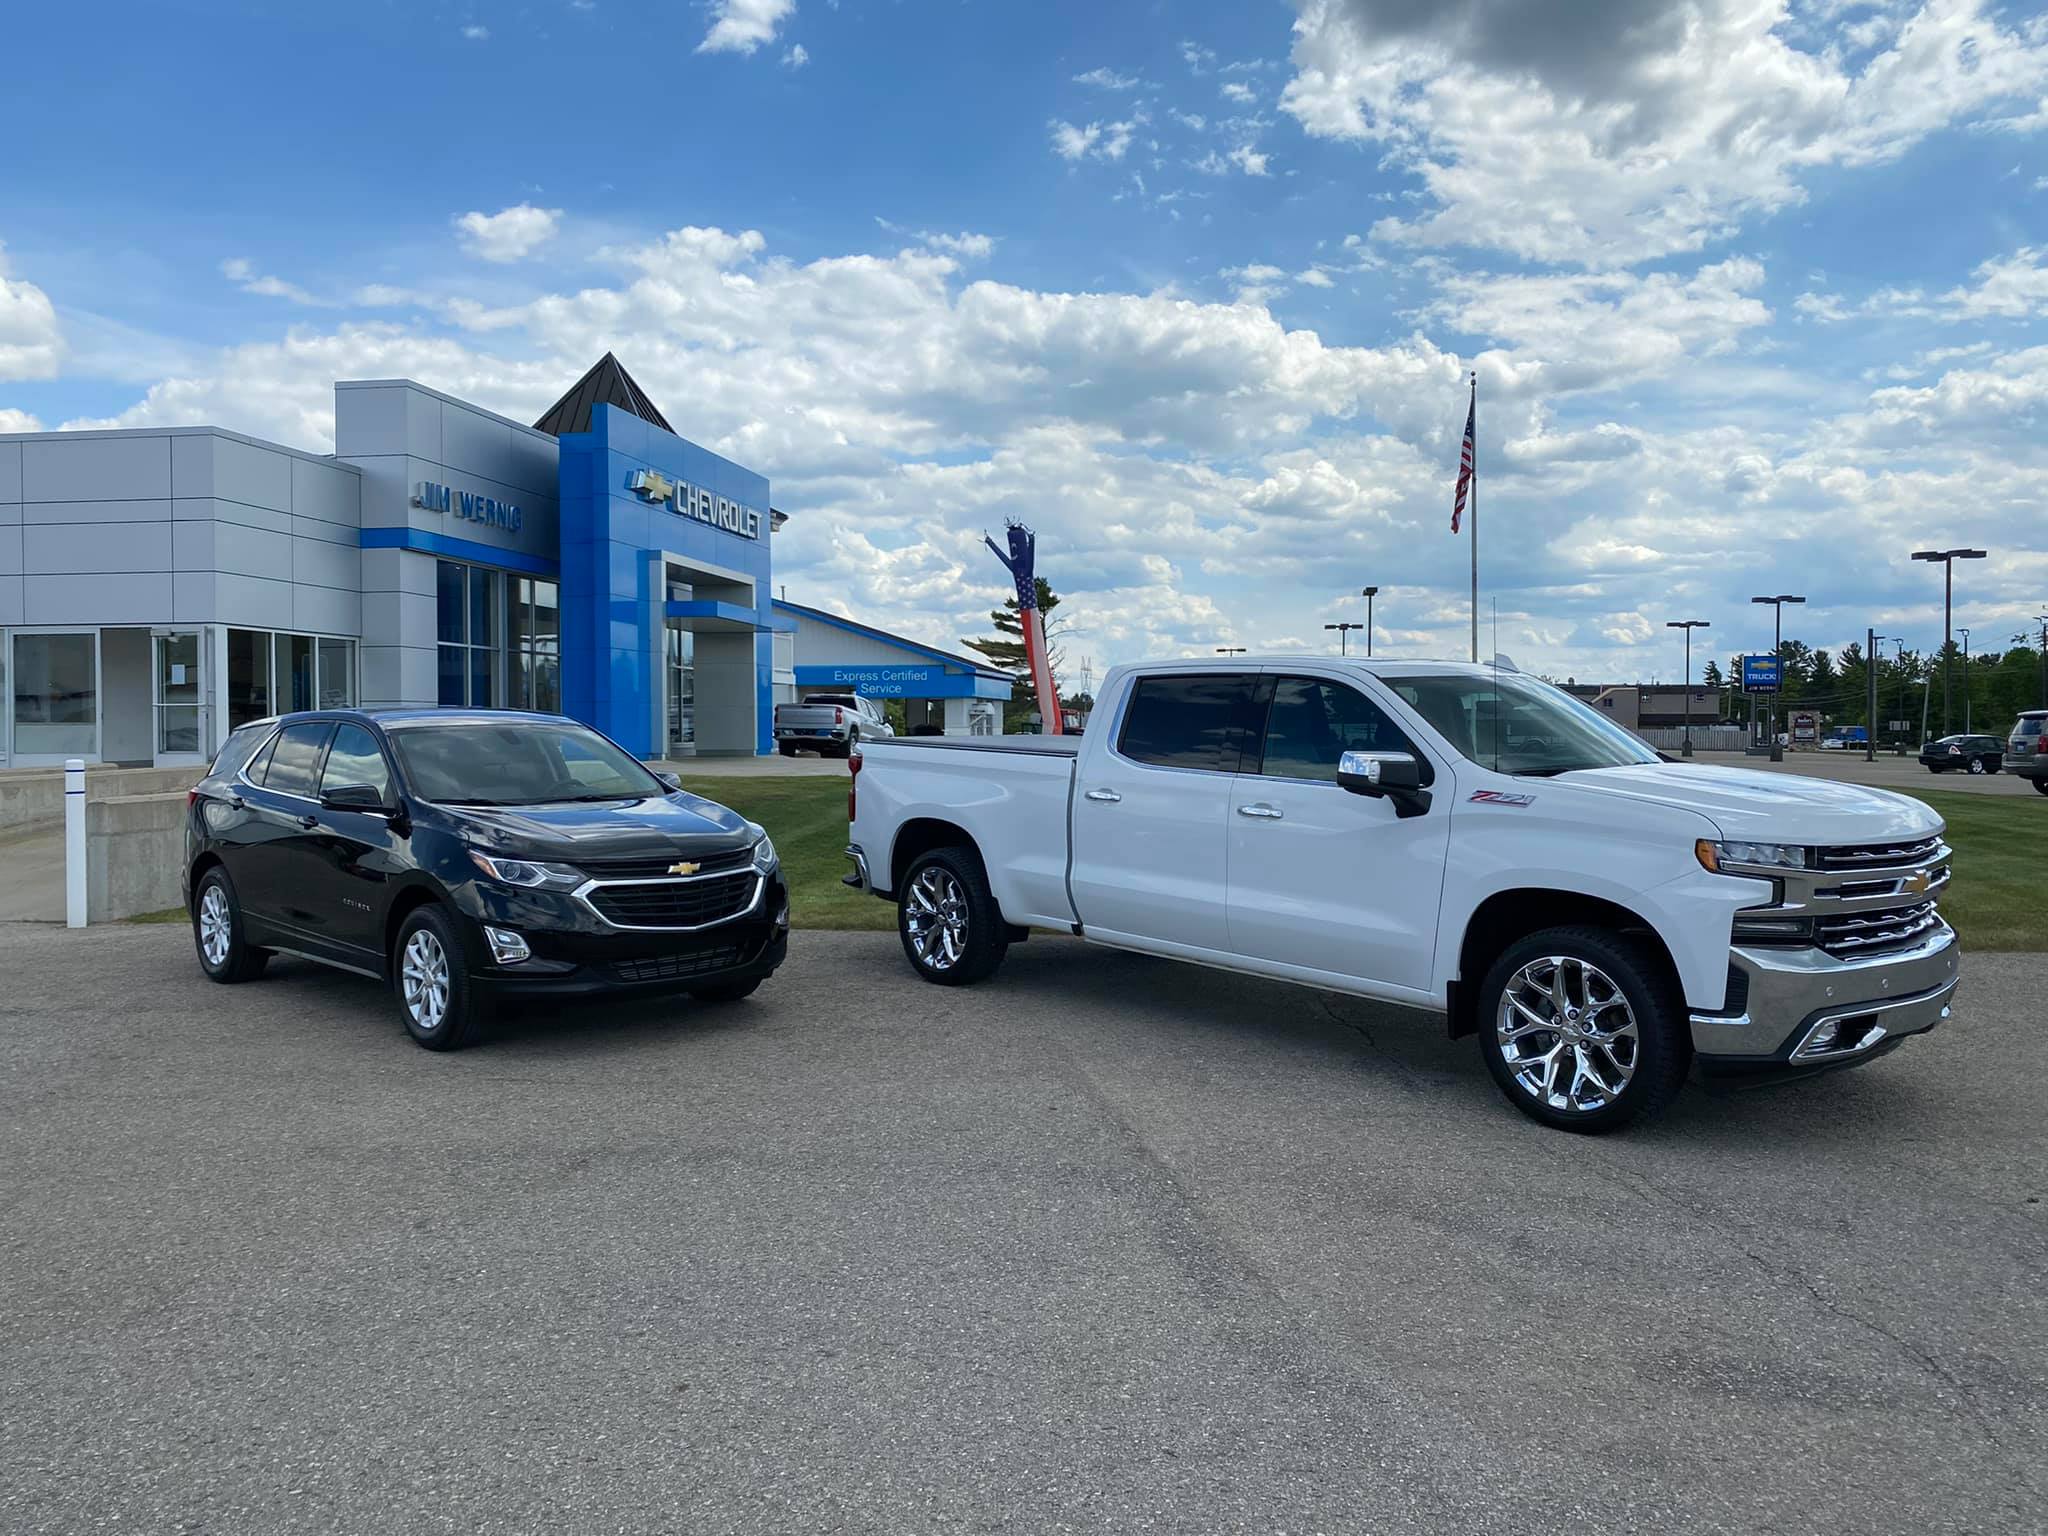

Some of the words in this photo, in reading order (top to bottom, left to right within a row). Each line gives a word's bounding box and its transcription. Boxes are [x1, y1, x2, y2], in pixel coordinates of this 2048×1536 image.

[411, 480, 450, 513] JIM
[453, 490, 522, 532] WERNIG
[676, 479, 762, 540] CHEVROLET
[834, 670, 879, 684] Express
[881, 670, 928, 681] Certified
[860, 683, 902, 694] Service
